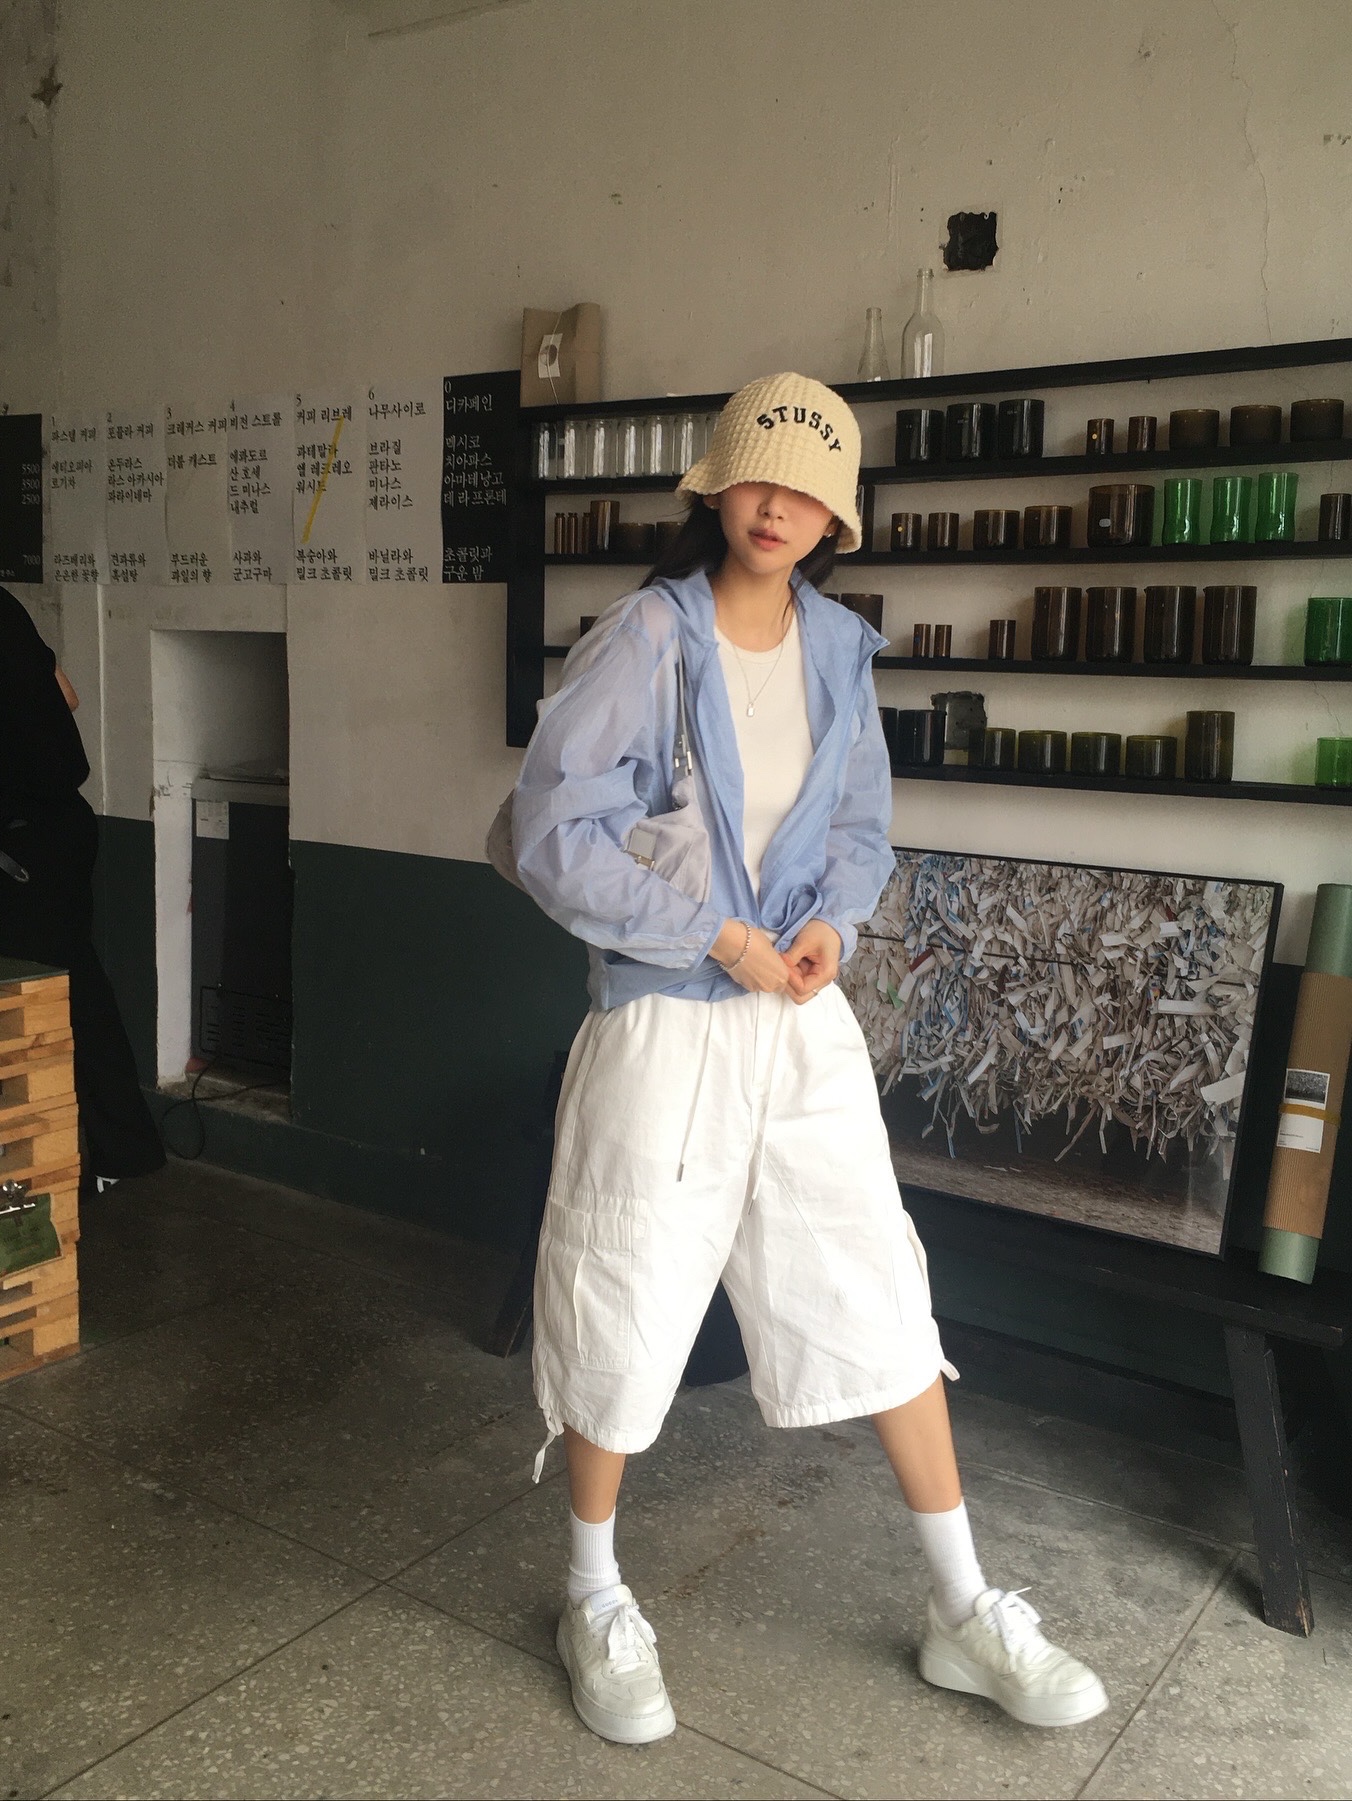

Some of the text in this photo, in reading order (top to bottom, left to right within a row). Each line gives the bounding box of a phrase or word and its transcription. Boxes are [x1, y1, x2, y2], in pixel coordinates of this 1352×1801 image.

[296, 394, 302, 407] 5
[368, 389, 375, 400] 6
[230, 400, 235, 411] 4
[369, 401, 426, 420] 나무사이로
[446, 393, 493, 414] 디카페인
[166, 407, 172, 420] 3
[230, 413, 248, 430] 비전
[296, 405, 352, 425] 커피 리브레
[137, 422, 154, 438] 커피
[208, 417, 227, 434] 커피
[757, 405, 842, 452] STUSSY
[80, 427, 97, 442] 커피
[229, 448, 269, 464] 에콰도르
[369, 439, 402, 457] 브라질
[51, 459, 93, 474] 에티오피아
[107, 456, 143, 472] 온두라스
[445, 452, 492, 470] 치아파스
[127, 471, 165, 487] 아카시아
[369, 476, 402, 493] 미나스
[444, 470, 503, 488] 아마테낭고
[229, 482, 271, 497] 드 미나스
[369, 494, 414, 511] 제라이스
[458, 490, 470, 507] 라
[171, 552, 208, 567] 부드러운
[233, 549, 262, 565] 사과와
[296, 548, 338, 564] 복숭아와
[368, 548, 414, 564] 바닐라와
[444, 545, 493, 563] 초콜릿과
[171, 568, 199, 584] 과일의
[233, 566, 273, 582] 군고구마
[296, 565, 353, 582] 밀크 초콜릿
[368, 566, 429, 582] 밀크 초콜릿
[443, 564, 485, 582] 구운 밤
